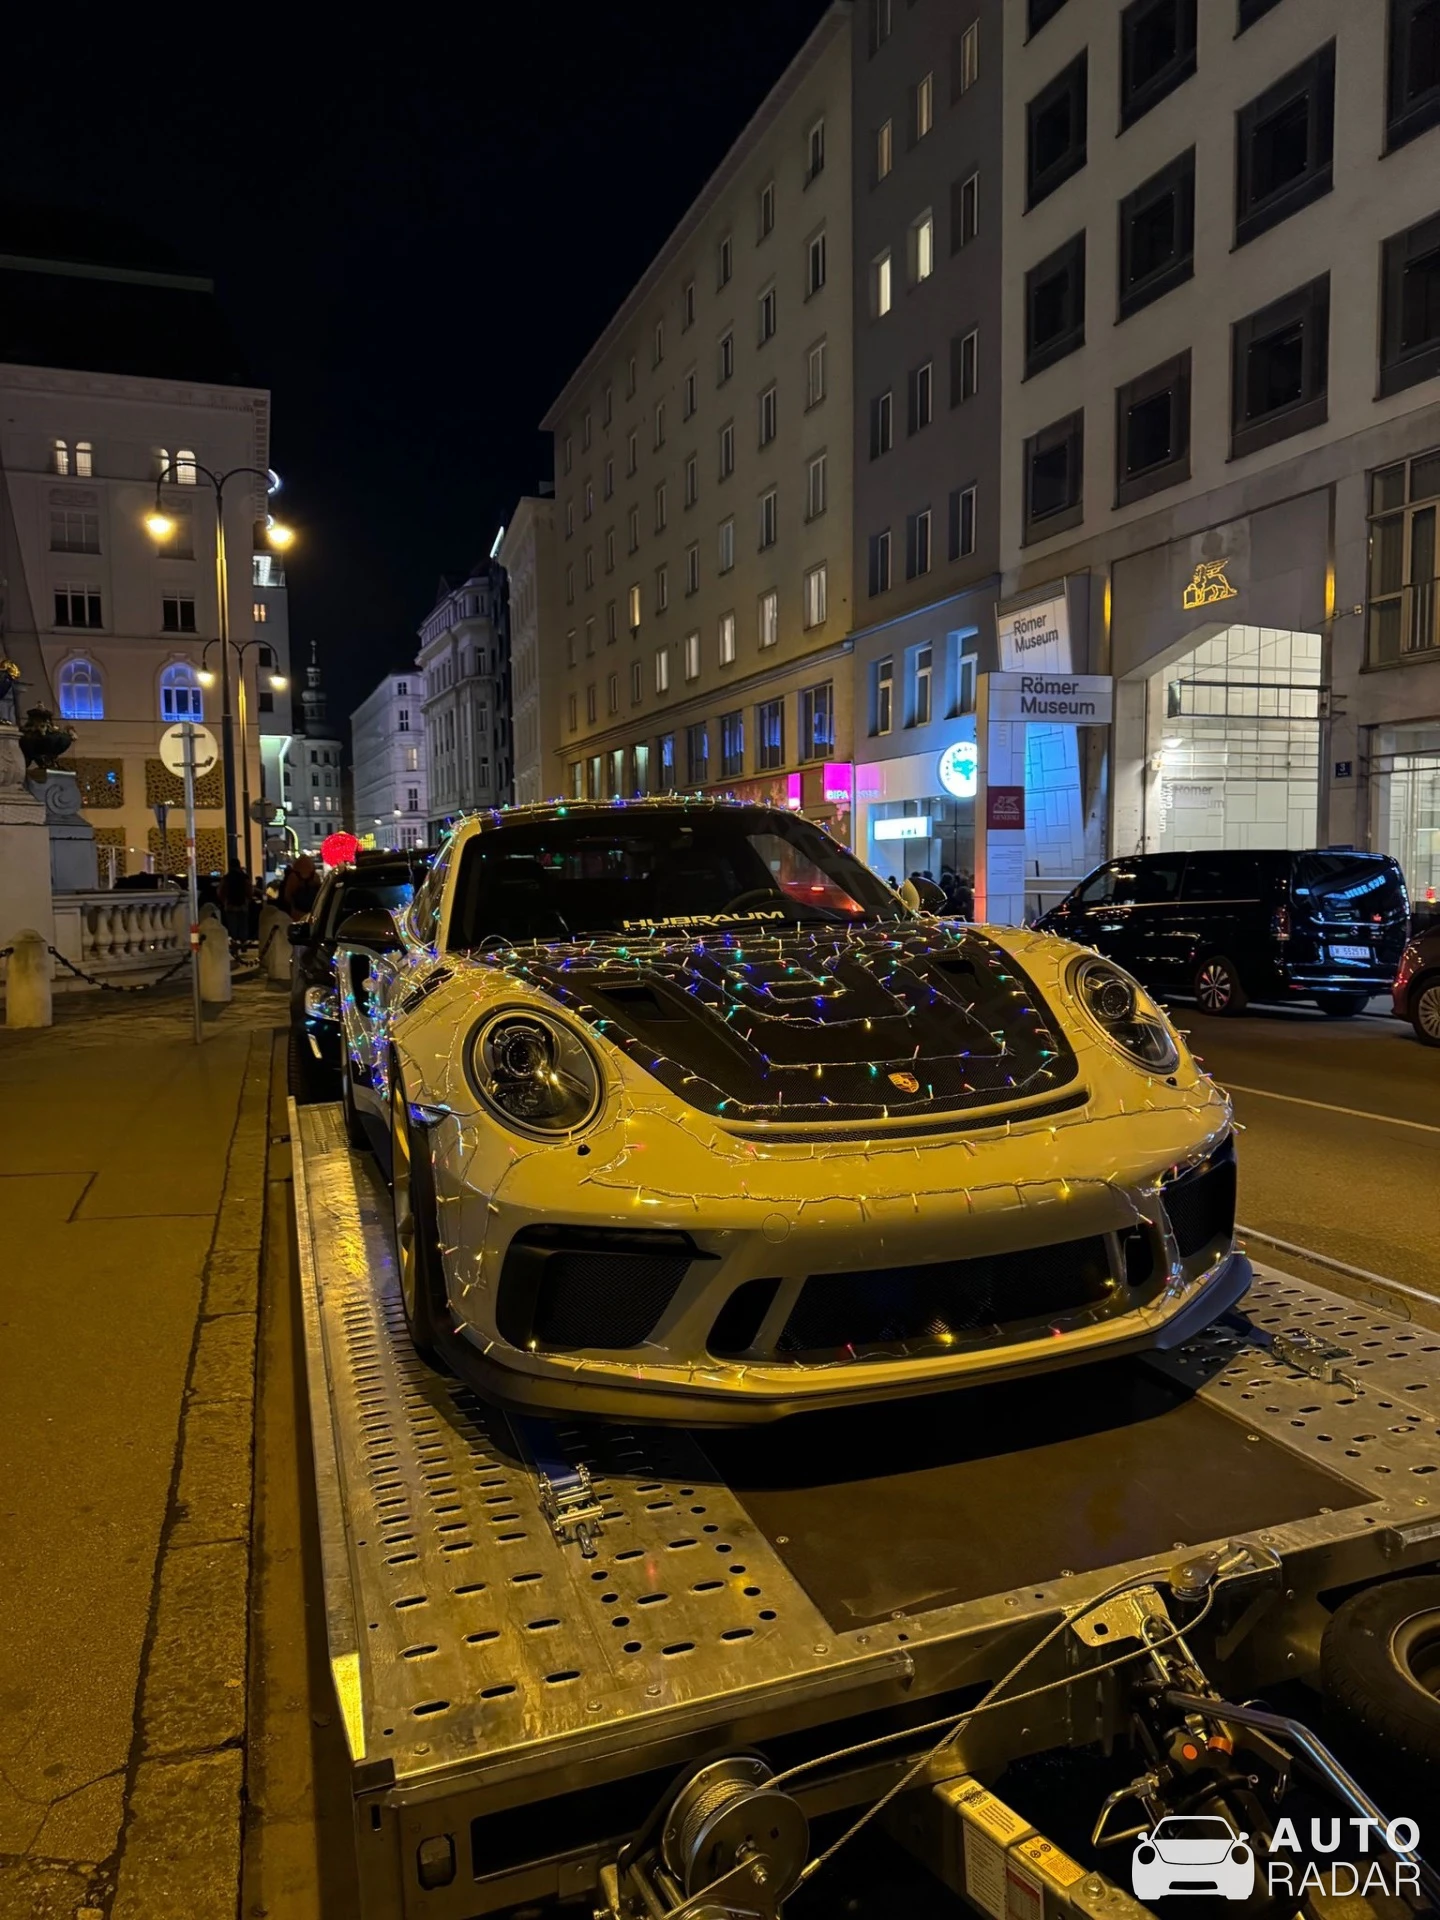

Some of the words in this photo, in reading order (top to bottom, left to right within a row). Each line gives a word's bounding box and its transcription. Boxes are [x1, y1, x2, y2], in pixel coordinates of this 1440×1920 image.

[1013, 614, 1047, 636] Römer
[1014, 629, 1059, 653] Museum
[1021, 676, 1079, 695] Römer
[1021, 696, 1095, 715] Museum
[826, 790, 849, 800] BIPA
[622, 911, 785, 929] HUBRAUM
